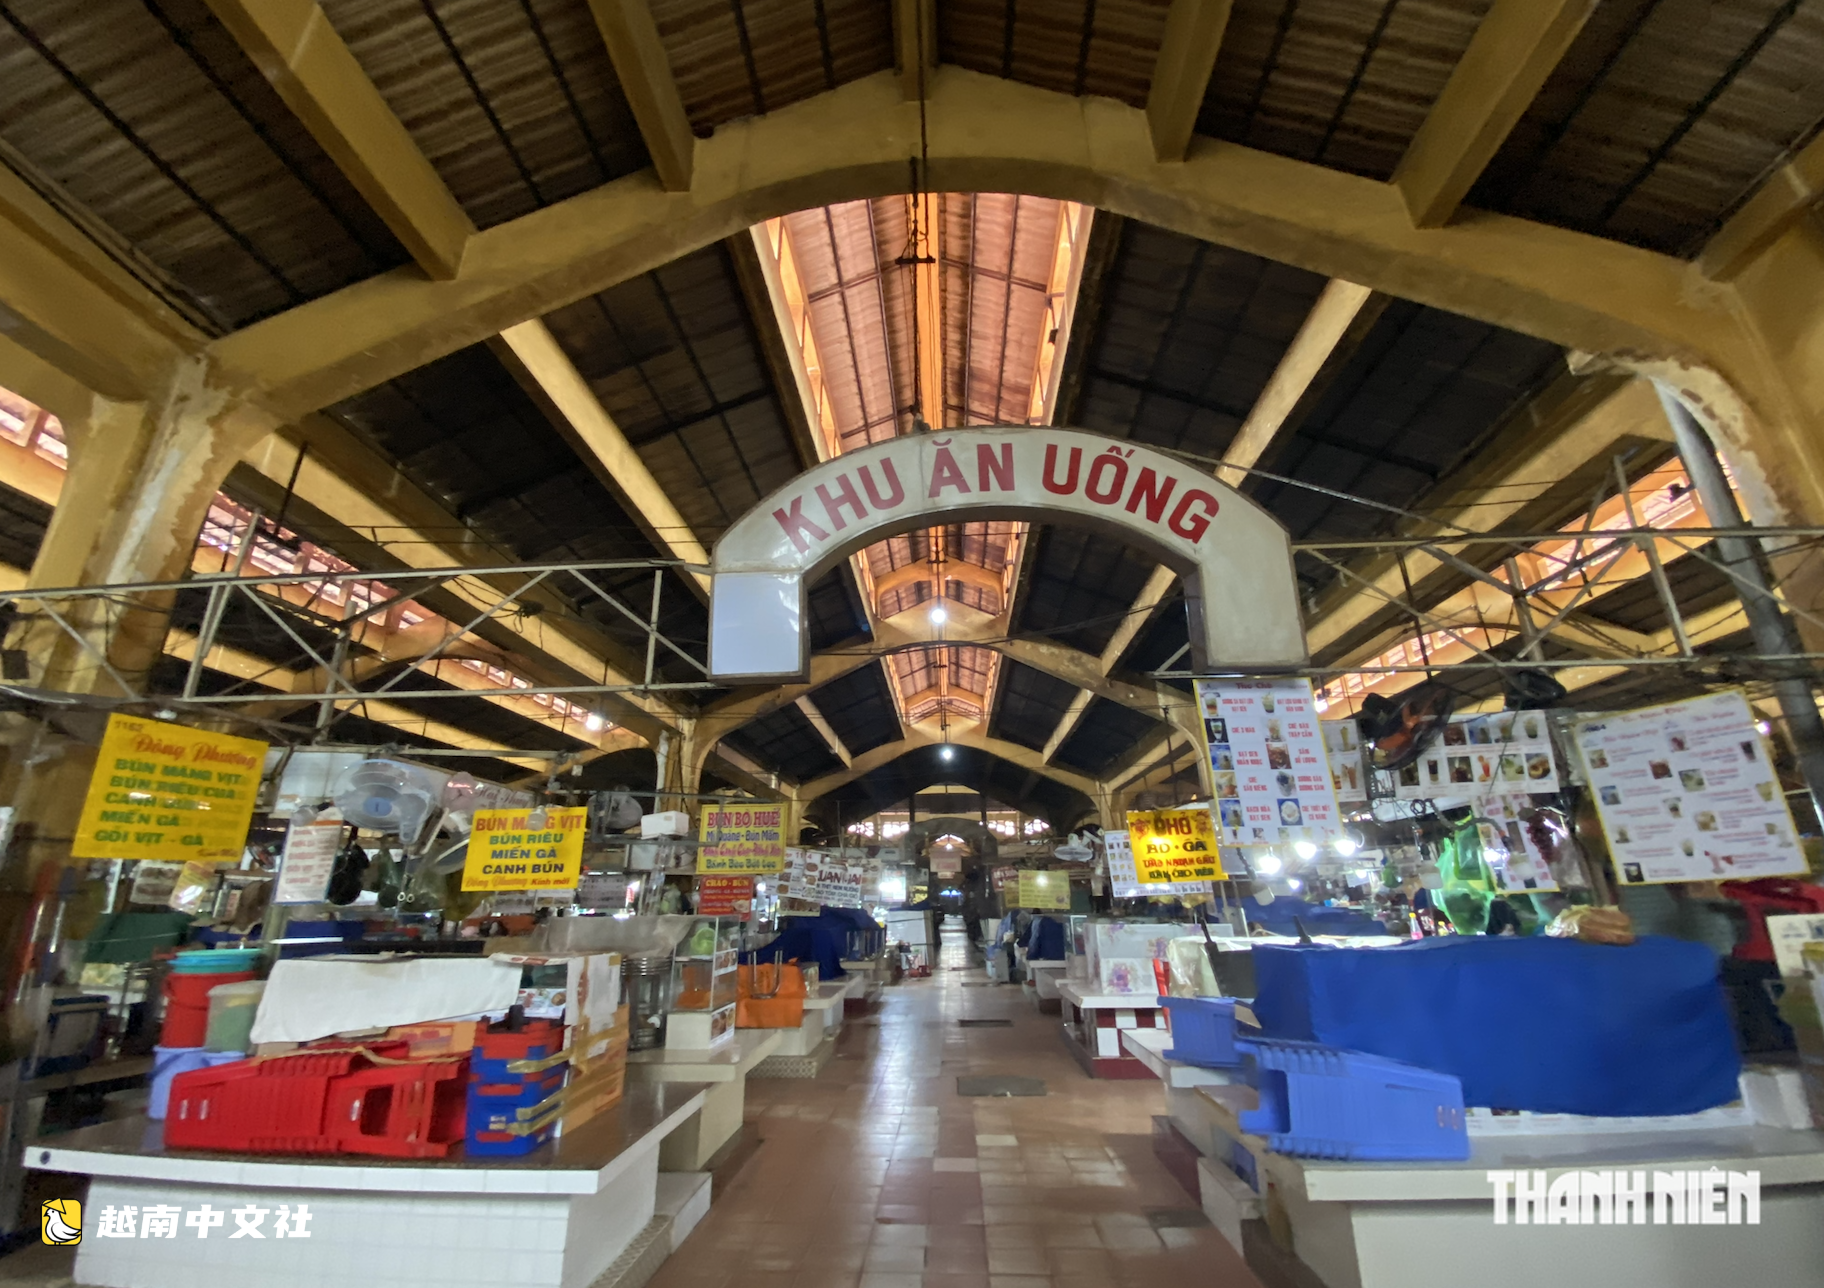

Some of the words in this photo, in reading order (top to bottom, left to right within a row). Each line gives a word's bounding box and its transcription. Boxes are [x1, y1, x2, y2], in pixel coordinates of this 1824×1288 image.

[772, 457, 904, 554] KHU
[928, 438, 1016, 498] ĂN
[1042, 444, 1220, 544] UỐNG
[115, 757, 156, 774] BÚN
[217, 771, 242, 786] VỊT
[476, 814, 507, 831] BÚN
[512, 815, 555, 831] MG
[561, 815, 584, 832] VỊT
[489, 832, 522, 845] BÚN
[527, 831, 564, 844] RIÊU
[1182, 838, 1207, 851] GÀ
[491, 846, 531, 859] MIẾN
[536, 846, 558, 859] GÀ
[482, 864, 527, 875] CANH
[531, 861, 565, 874] BÚN
